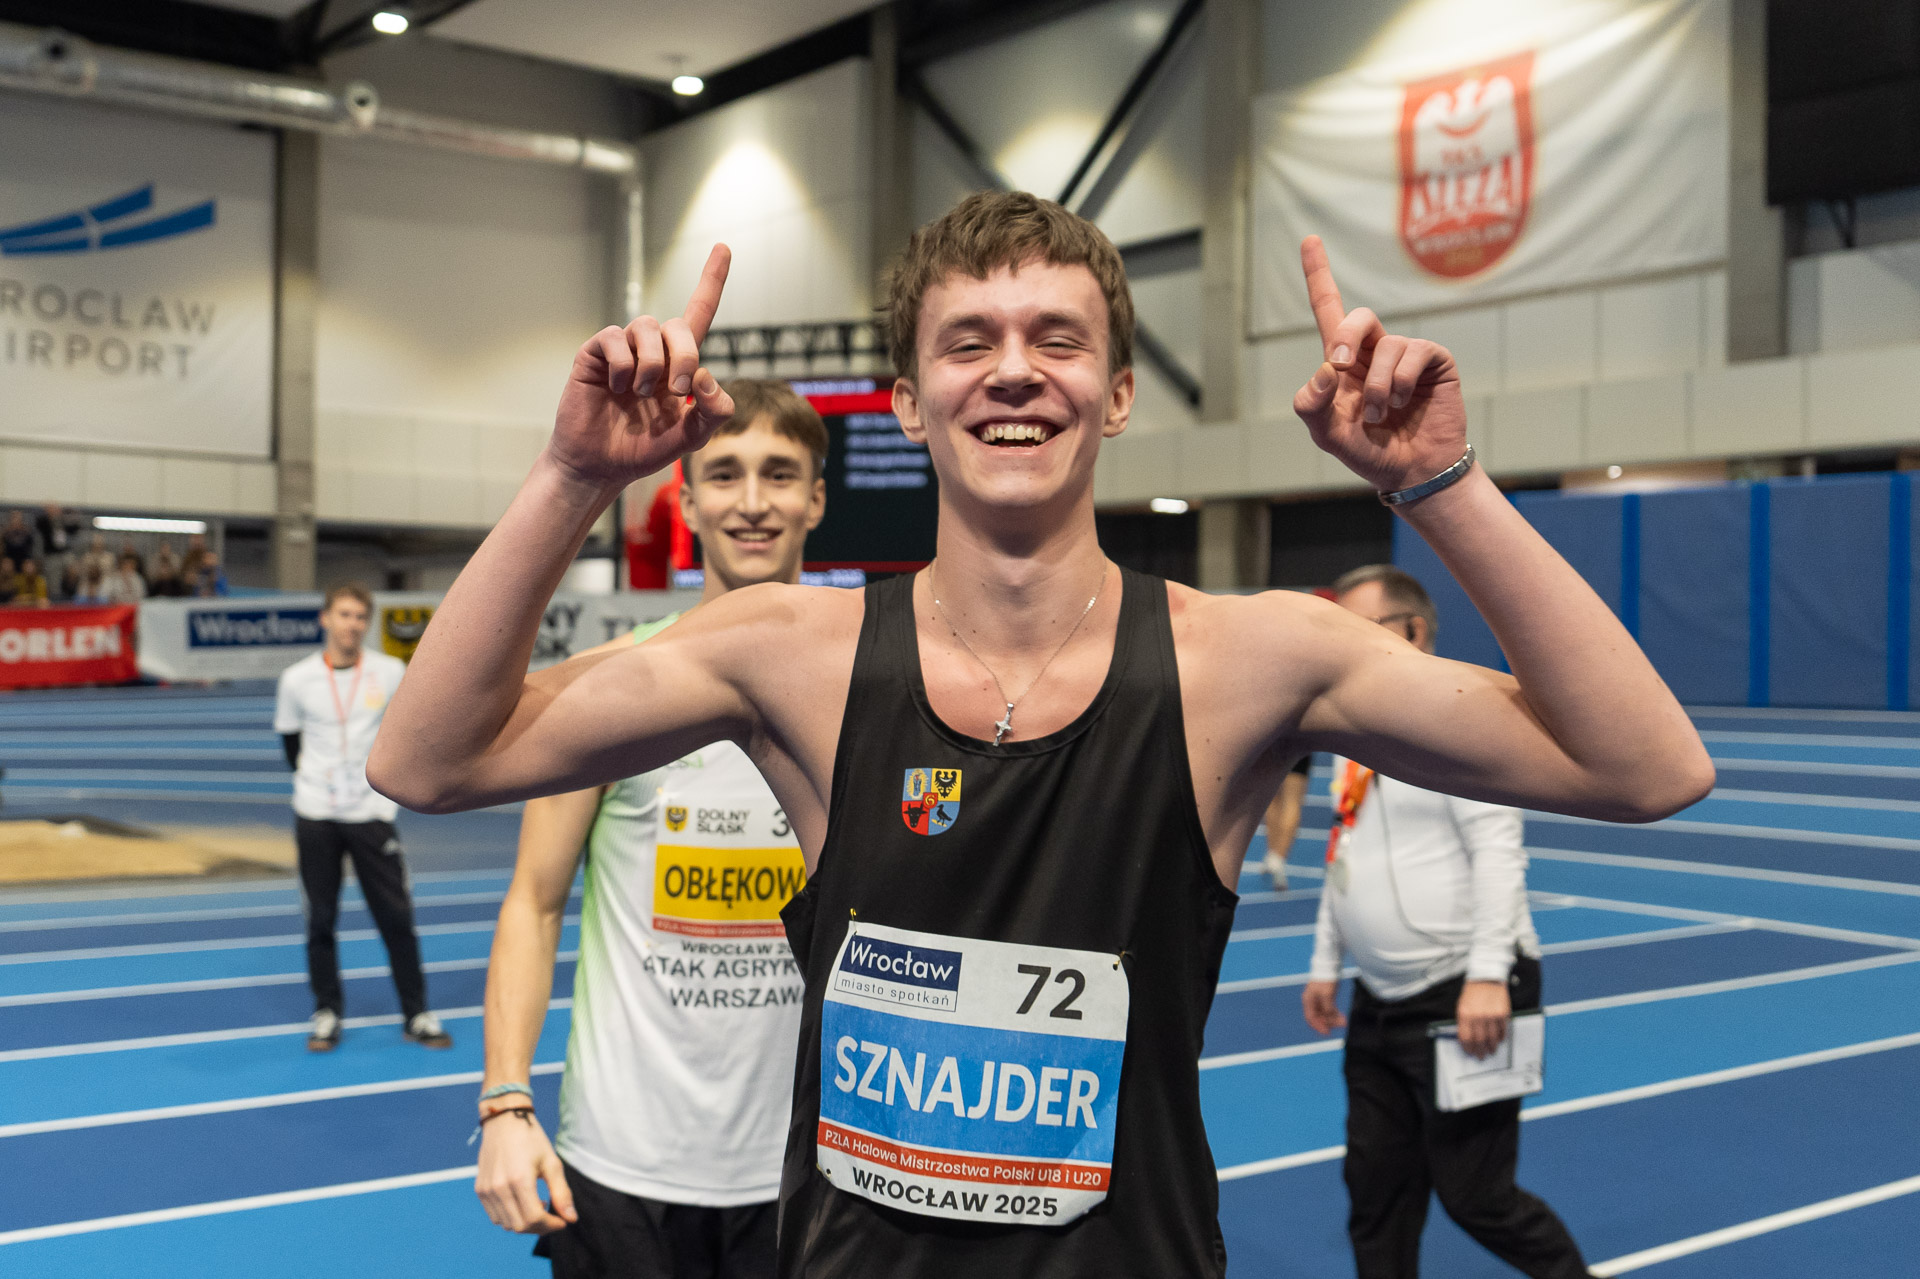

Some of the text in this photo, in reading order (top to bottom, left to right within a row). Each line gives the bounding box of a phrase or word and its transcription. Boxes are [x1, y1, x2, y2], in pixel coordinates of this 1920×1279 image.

[4, 328, 197, 379] IRPORT
[0, 624, 121, 664] ORLEN
[698, 808, 750, 821] DOLNY
[682, 940, 773, 955] WROCŁAW
[850, 940, 954, 982] Wrocław
[670, 985, 804, 1008] WARSZAW
[840, 978, 950, 1007] miasto spotkań
[1016, 962, 1087, 1021] 72
[834, 1035, 1100, 1129] SZNAJDER
[825, 1129, 850, 1149] PZLA
[853, 1138, 898, 1163] Halowe
[900, 1153, 989, 1178] Mistrzostwa
[993, 1165, 1035, 1182] Polski
[1038, 1168, 1062, 1183] U18
[1073, 1171, 1102, 1186] U20
[852, 1166, 1058, 1217] WROCŁAW 2025
